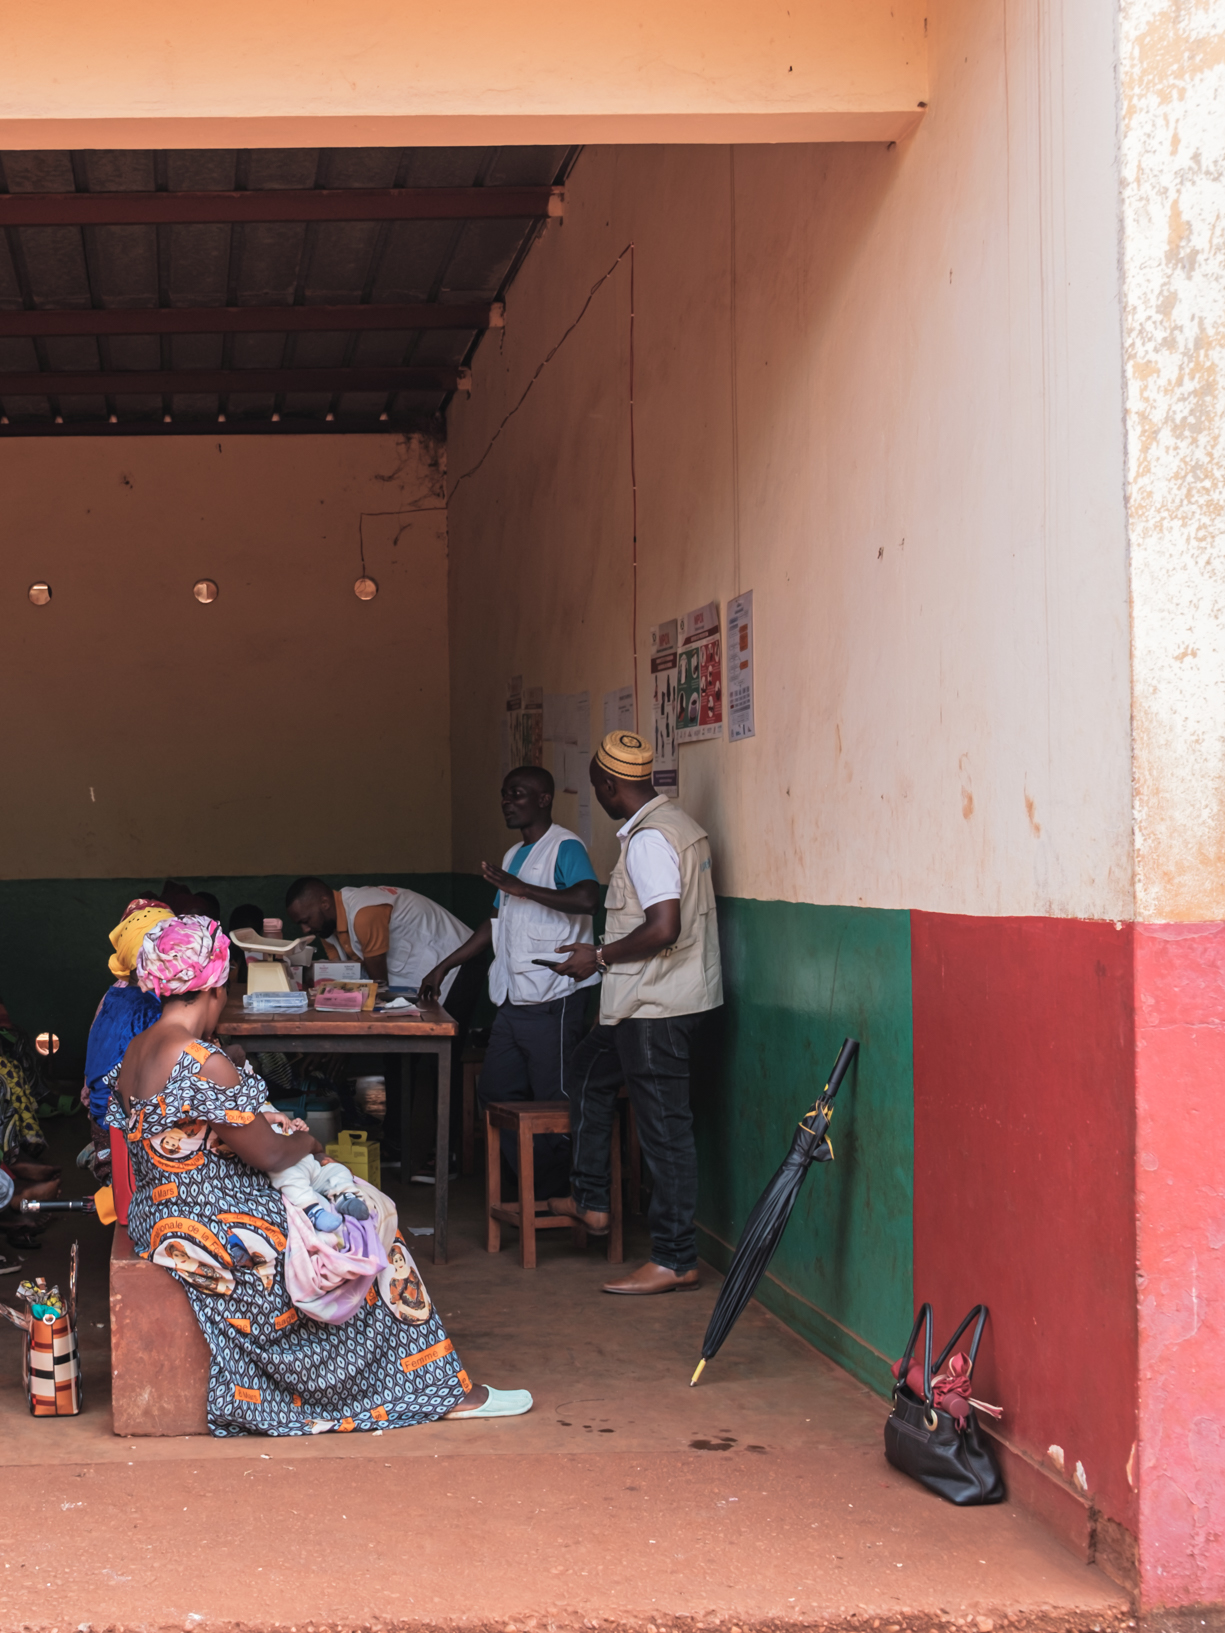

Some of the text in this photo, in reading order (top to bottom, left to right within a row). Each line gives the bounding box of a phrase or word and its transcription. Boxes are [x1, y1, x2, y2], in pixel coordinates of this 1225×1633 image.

[157, 1188, 174, 1198] Mars
[187, 1224, 200, 1234] de
[200, 1231, 210, 1242] la
[275, 1312, 296, 1328] sage
[404, 1350, 439, 1370] Femme
[242, 1391, 259, 1402] Mars
